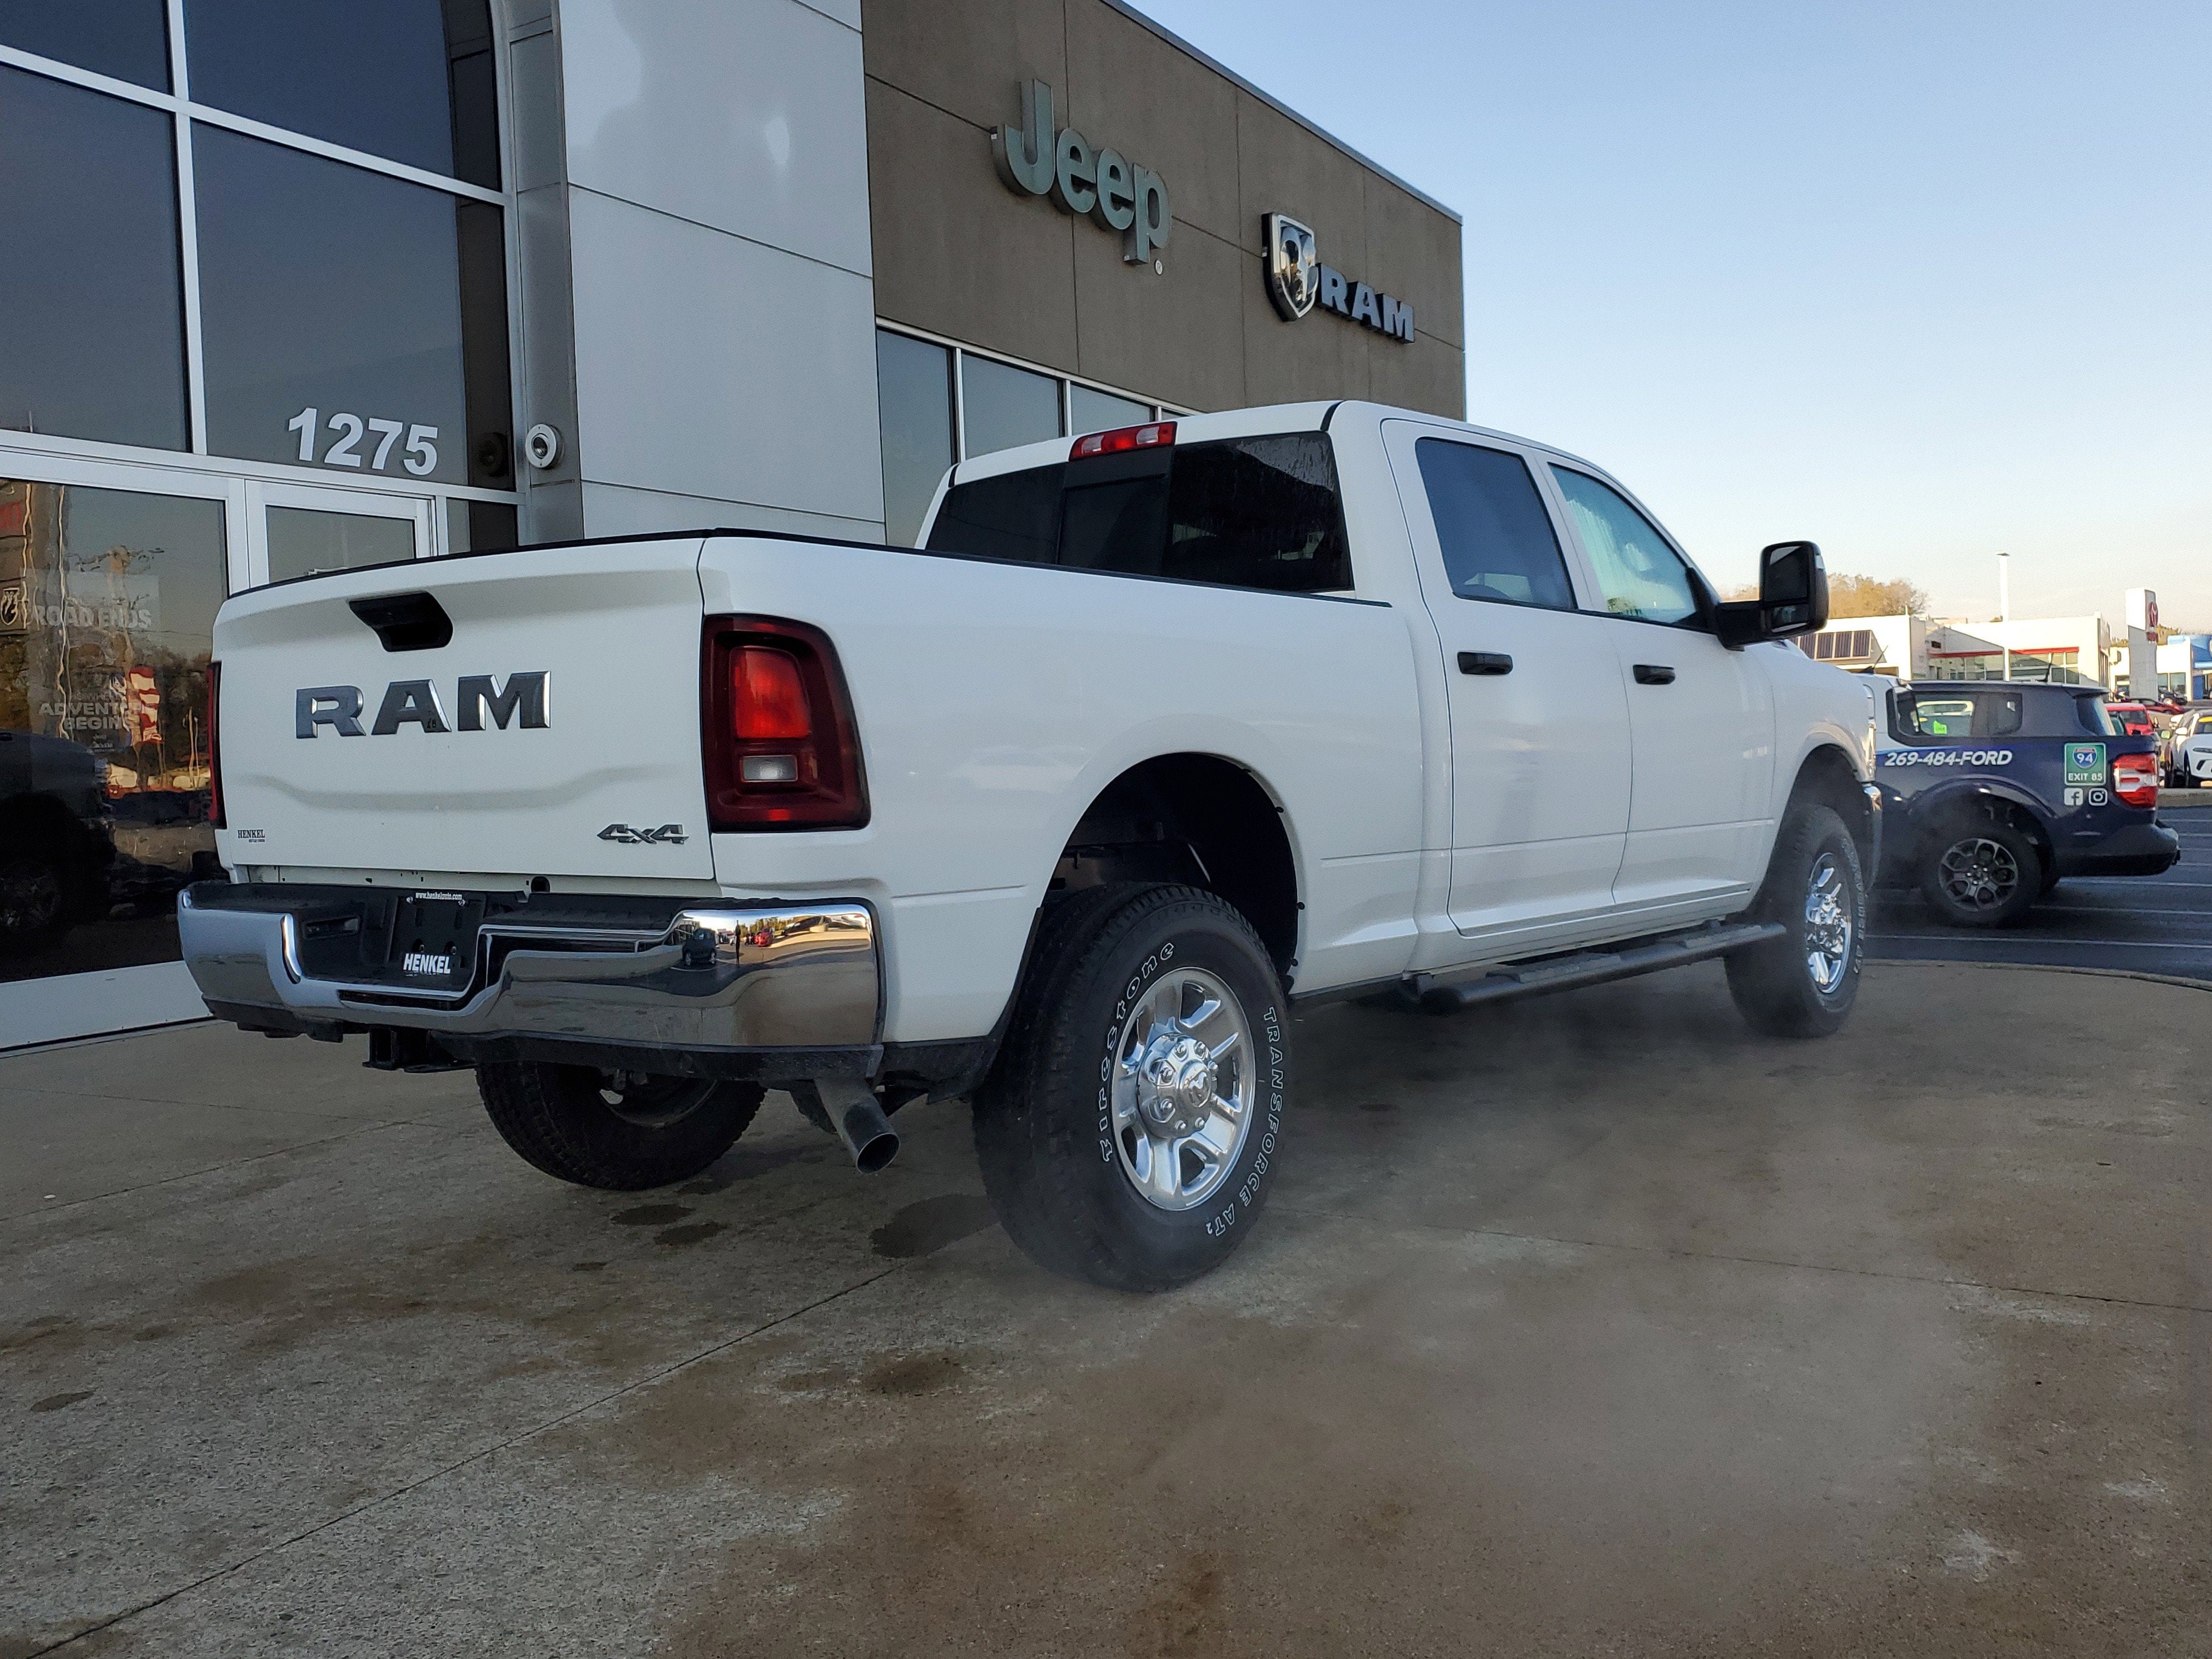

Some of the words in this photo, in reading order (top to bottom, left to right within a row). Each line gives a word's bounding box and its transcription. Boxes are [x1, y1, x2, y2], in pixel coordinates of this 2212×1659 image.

[992, 78, 1171, 265] Jeep
[1317, 262, 1415, 345] RAM
[288, 407, 438, 476] 1275
[296, 671, 551, 738] RAM
[1884, 750, 2013, 766] 269-484-FORD
[2076, 753, 2093, 764] 94
[2068, 772, 2088, 781] EXIT
[238, 829, 266, 839] HENKEL
[597, 823, 689, 844] 4x4
[403, 953, 451, 974] HENKEL
[1239, 1007, 1284, 1207] TRANSFORCE
